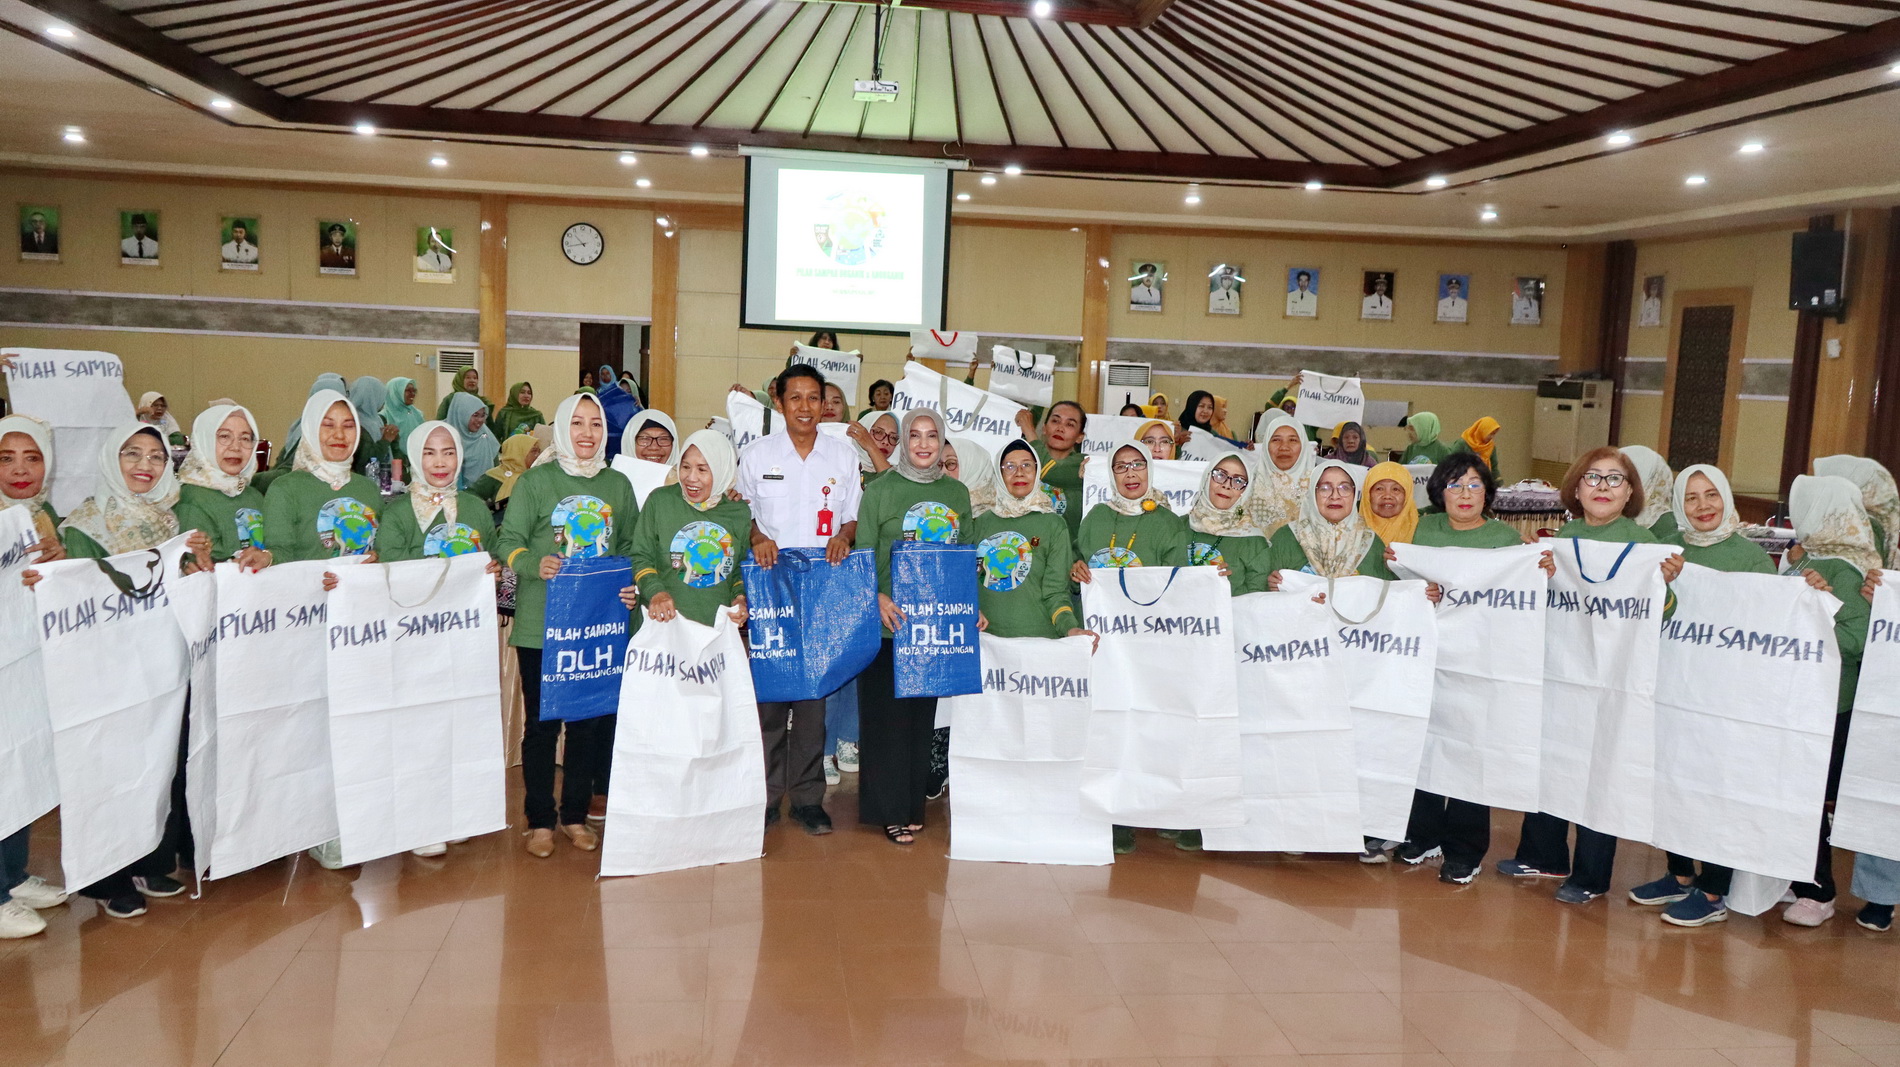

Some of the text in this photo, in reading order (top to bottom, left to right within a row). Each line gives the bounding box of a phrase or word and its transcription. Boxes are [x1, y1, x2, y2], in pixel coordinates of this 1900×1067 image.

[820, 359, 857, 374] SAMPAH
[1299, 388, 1360, 406] PILAH SAMPAH
[901, 603, 974, 616] PILAH SAMPAH
[1446, 588, 1537, 611] SAMPAH
[1584, 595, 1651, 620] SAMPAH
[42, 597, 97, 641] PILAH
[219, 608, 276, 641] PILAH
[329, 608, 479, 651] PILAH SAMPAH
[546, 621, 625, 641] PILAH SAMPAH
[1086, 614, 1221, 637] PILAH SAMPAH
[748, 626, 784, 650] LH
[911, 622, 965, 646] DLH
[1338, 626, 1421, 657] SAMPAH
[1715, 626, 1824, 664] SAMPAH
[556, 644, 613, 673] DLH
[898, 645, 975, 657] KOTA PEKALONGAN
[1241, 636, 1330, 663] SAMPAH
[625, 648, 675, 678] PILAH
[542, 673, 566, 683] KOTA
[1008, 670, 1089, 698] SAMPAH
